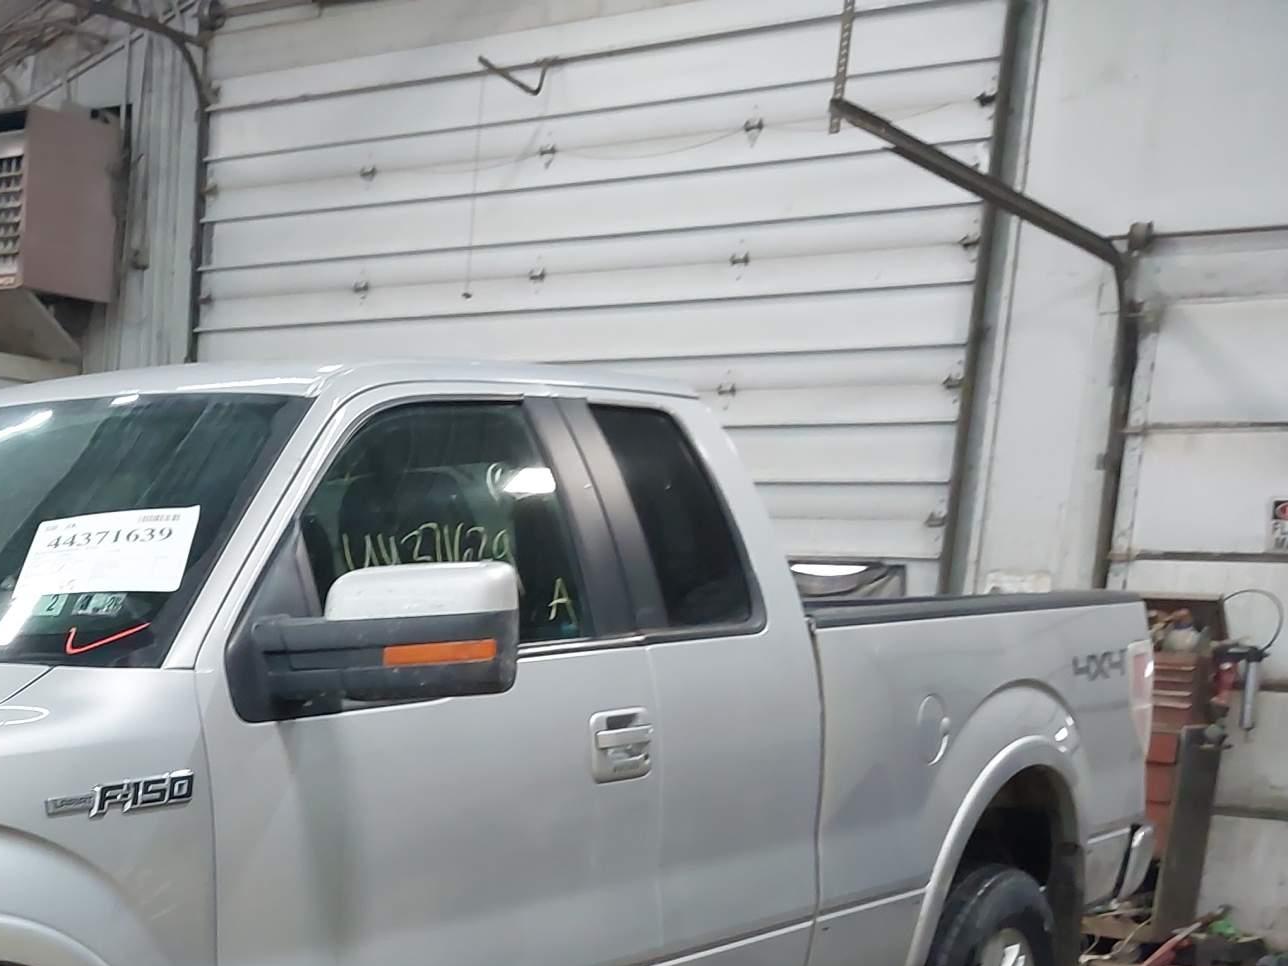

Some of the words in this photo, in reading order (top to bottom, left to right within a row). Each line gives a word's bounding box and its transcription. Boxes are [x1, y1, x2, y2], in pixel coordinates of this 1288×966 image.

[47, 527, 173, 549] 44371639
[547, 577, 578, 625] A
[89, 769, 194, 818] F-150
